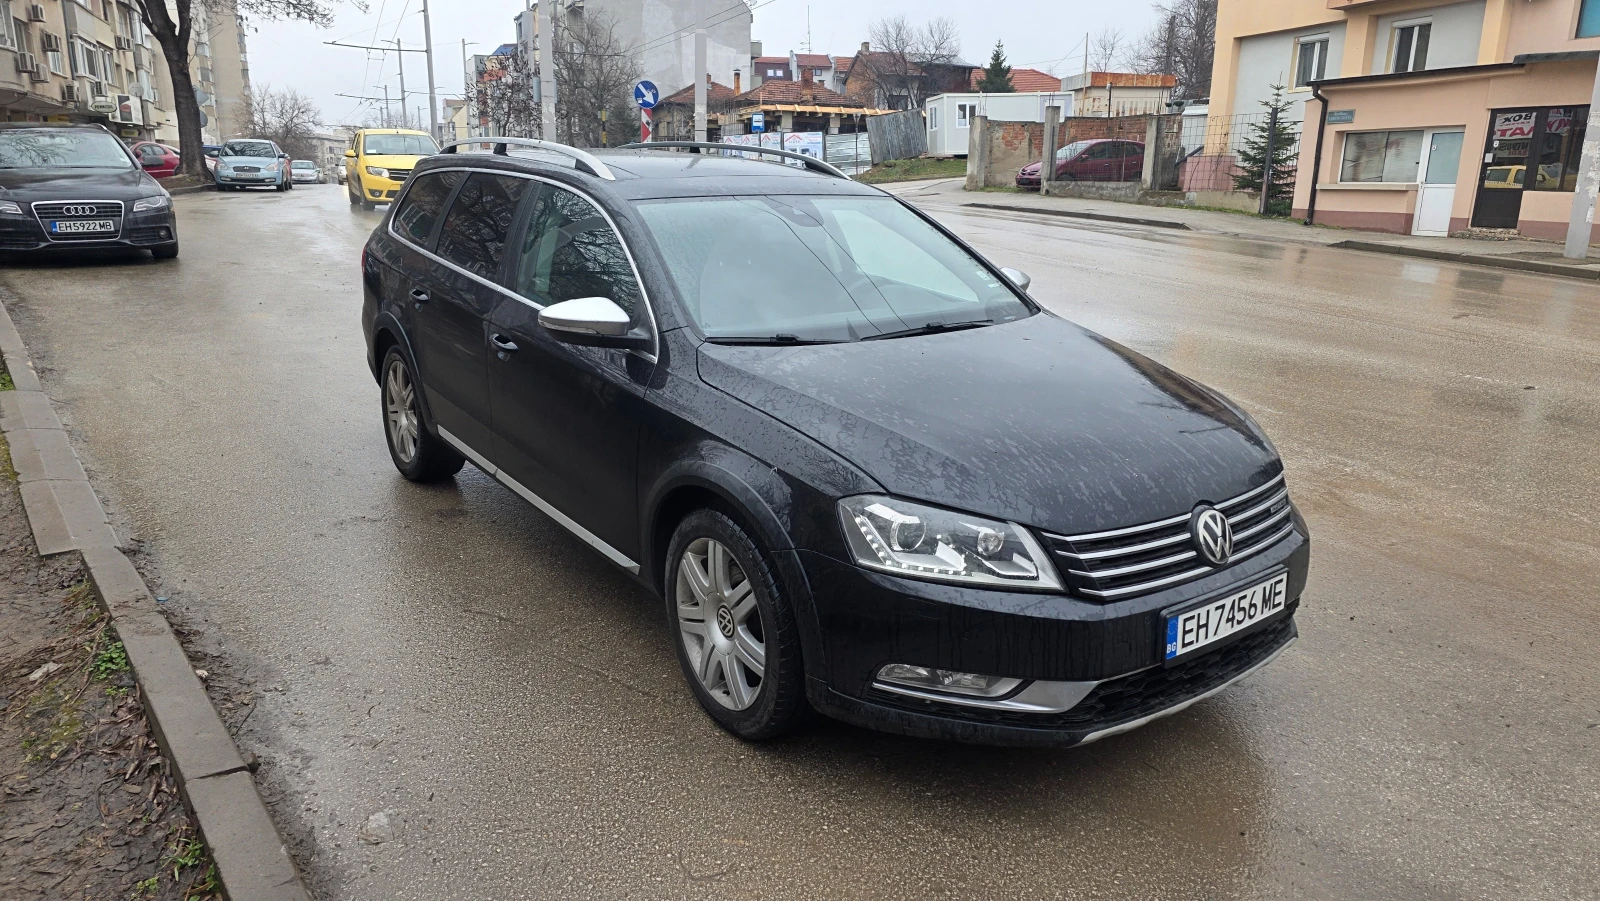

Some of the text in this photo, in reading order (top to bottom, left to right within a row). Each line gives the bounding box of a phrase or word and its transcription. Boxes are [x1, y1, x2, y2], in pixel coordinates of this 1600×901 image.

[58, 221, 112, 232] EH 5922 MB
[1182, 578, 1284, 649] EH 7456 ME
[1166, 641, 1177, 654] BG
